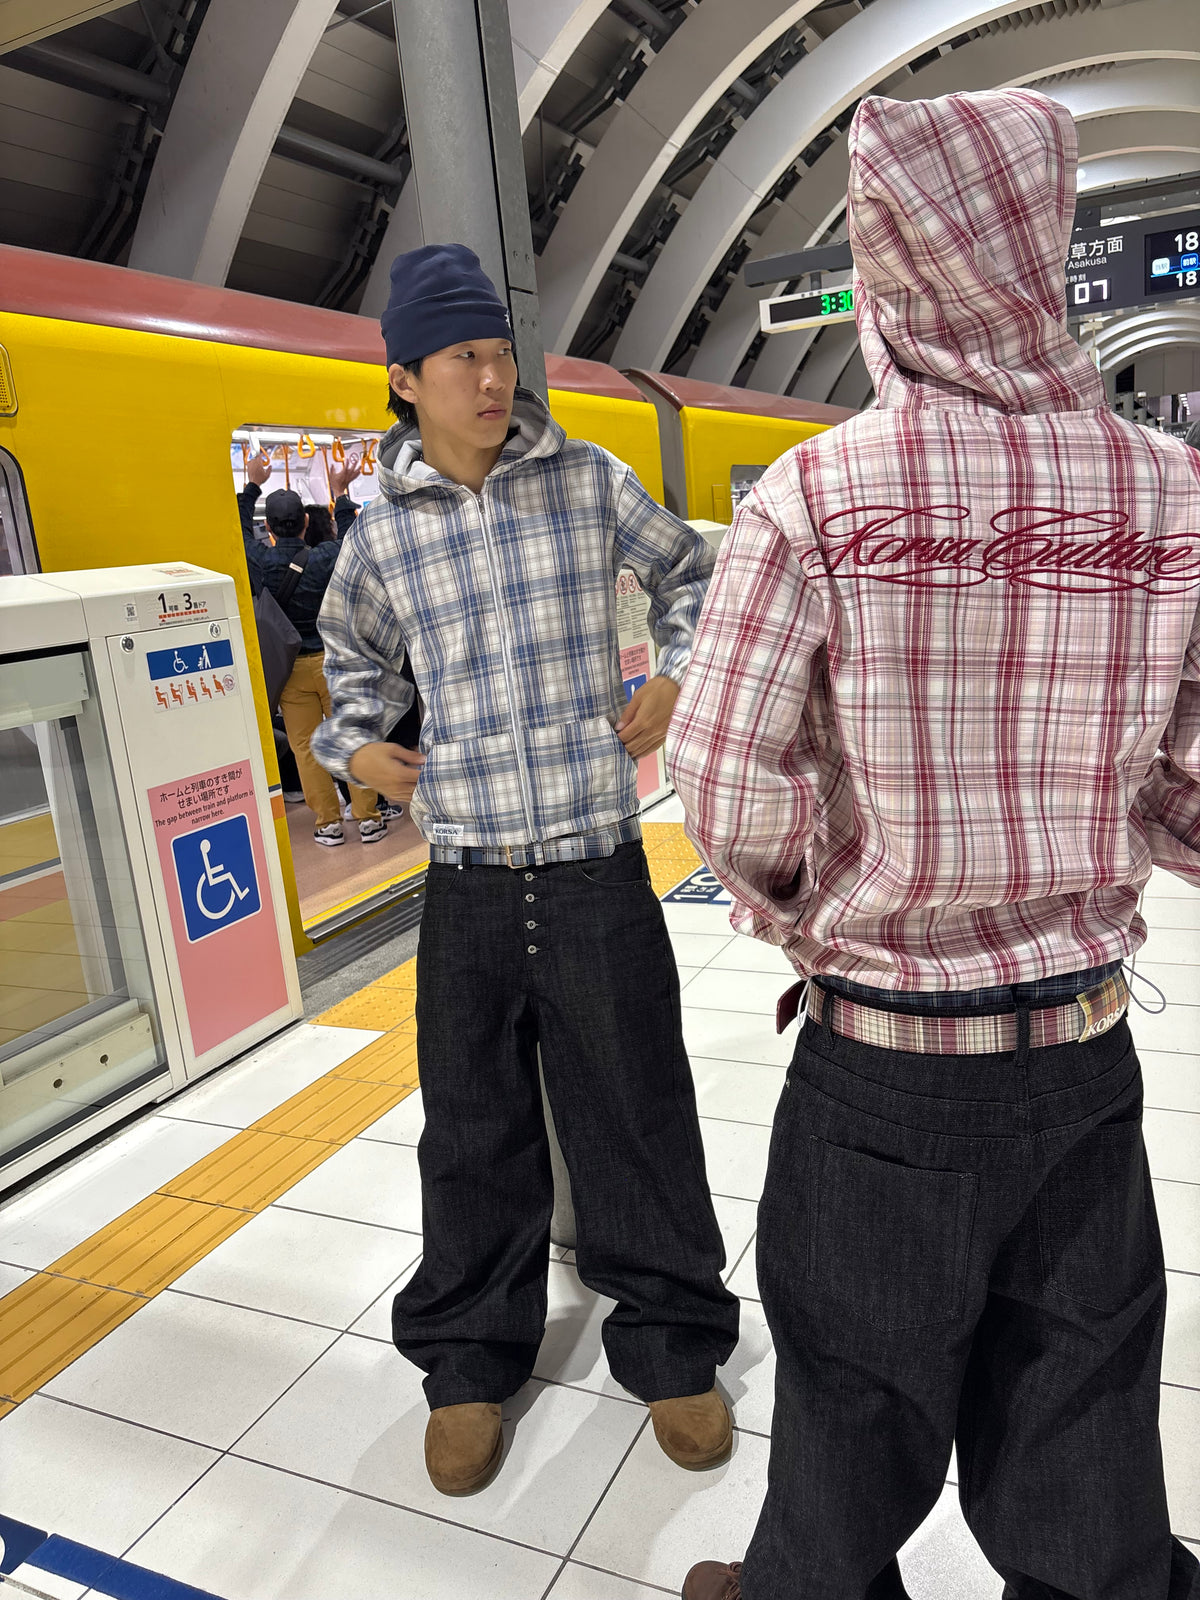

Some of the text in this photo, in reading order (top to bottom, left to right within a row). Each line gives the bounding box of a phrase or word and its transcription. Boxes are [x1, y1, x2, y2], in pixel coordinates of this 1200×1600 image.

[1066, 235, 1123, 261] 草方面
[1174, 231, 1199, 253] 18
[1067, 256, 1107, 270] Asakusa
[1176, 271, 1198, 287] 18
[821, 289, 855, 315] 3:30
[799, 504, 1200, 595] Korsa Culture
[159, 768, 242, 803] ホームと列車のすき間が
[177, 784, 230, 809] せまい場所です
[155, 819, 166, 828] The
[166, 815, 178, 826] gap
[178, 807, 203, 819] between
[203, 802, 216, 813] train
[216, 797, 227, 807] and
[227, 790, 249, 804] platform
[191, 814, 211, 825] narrow
